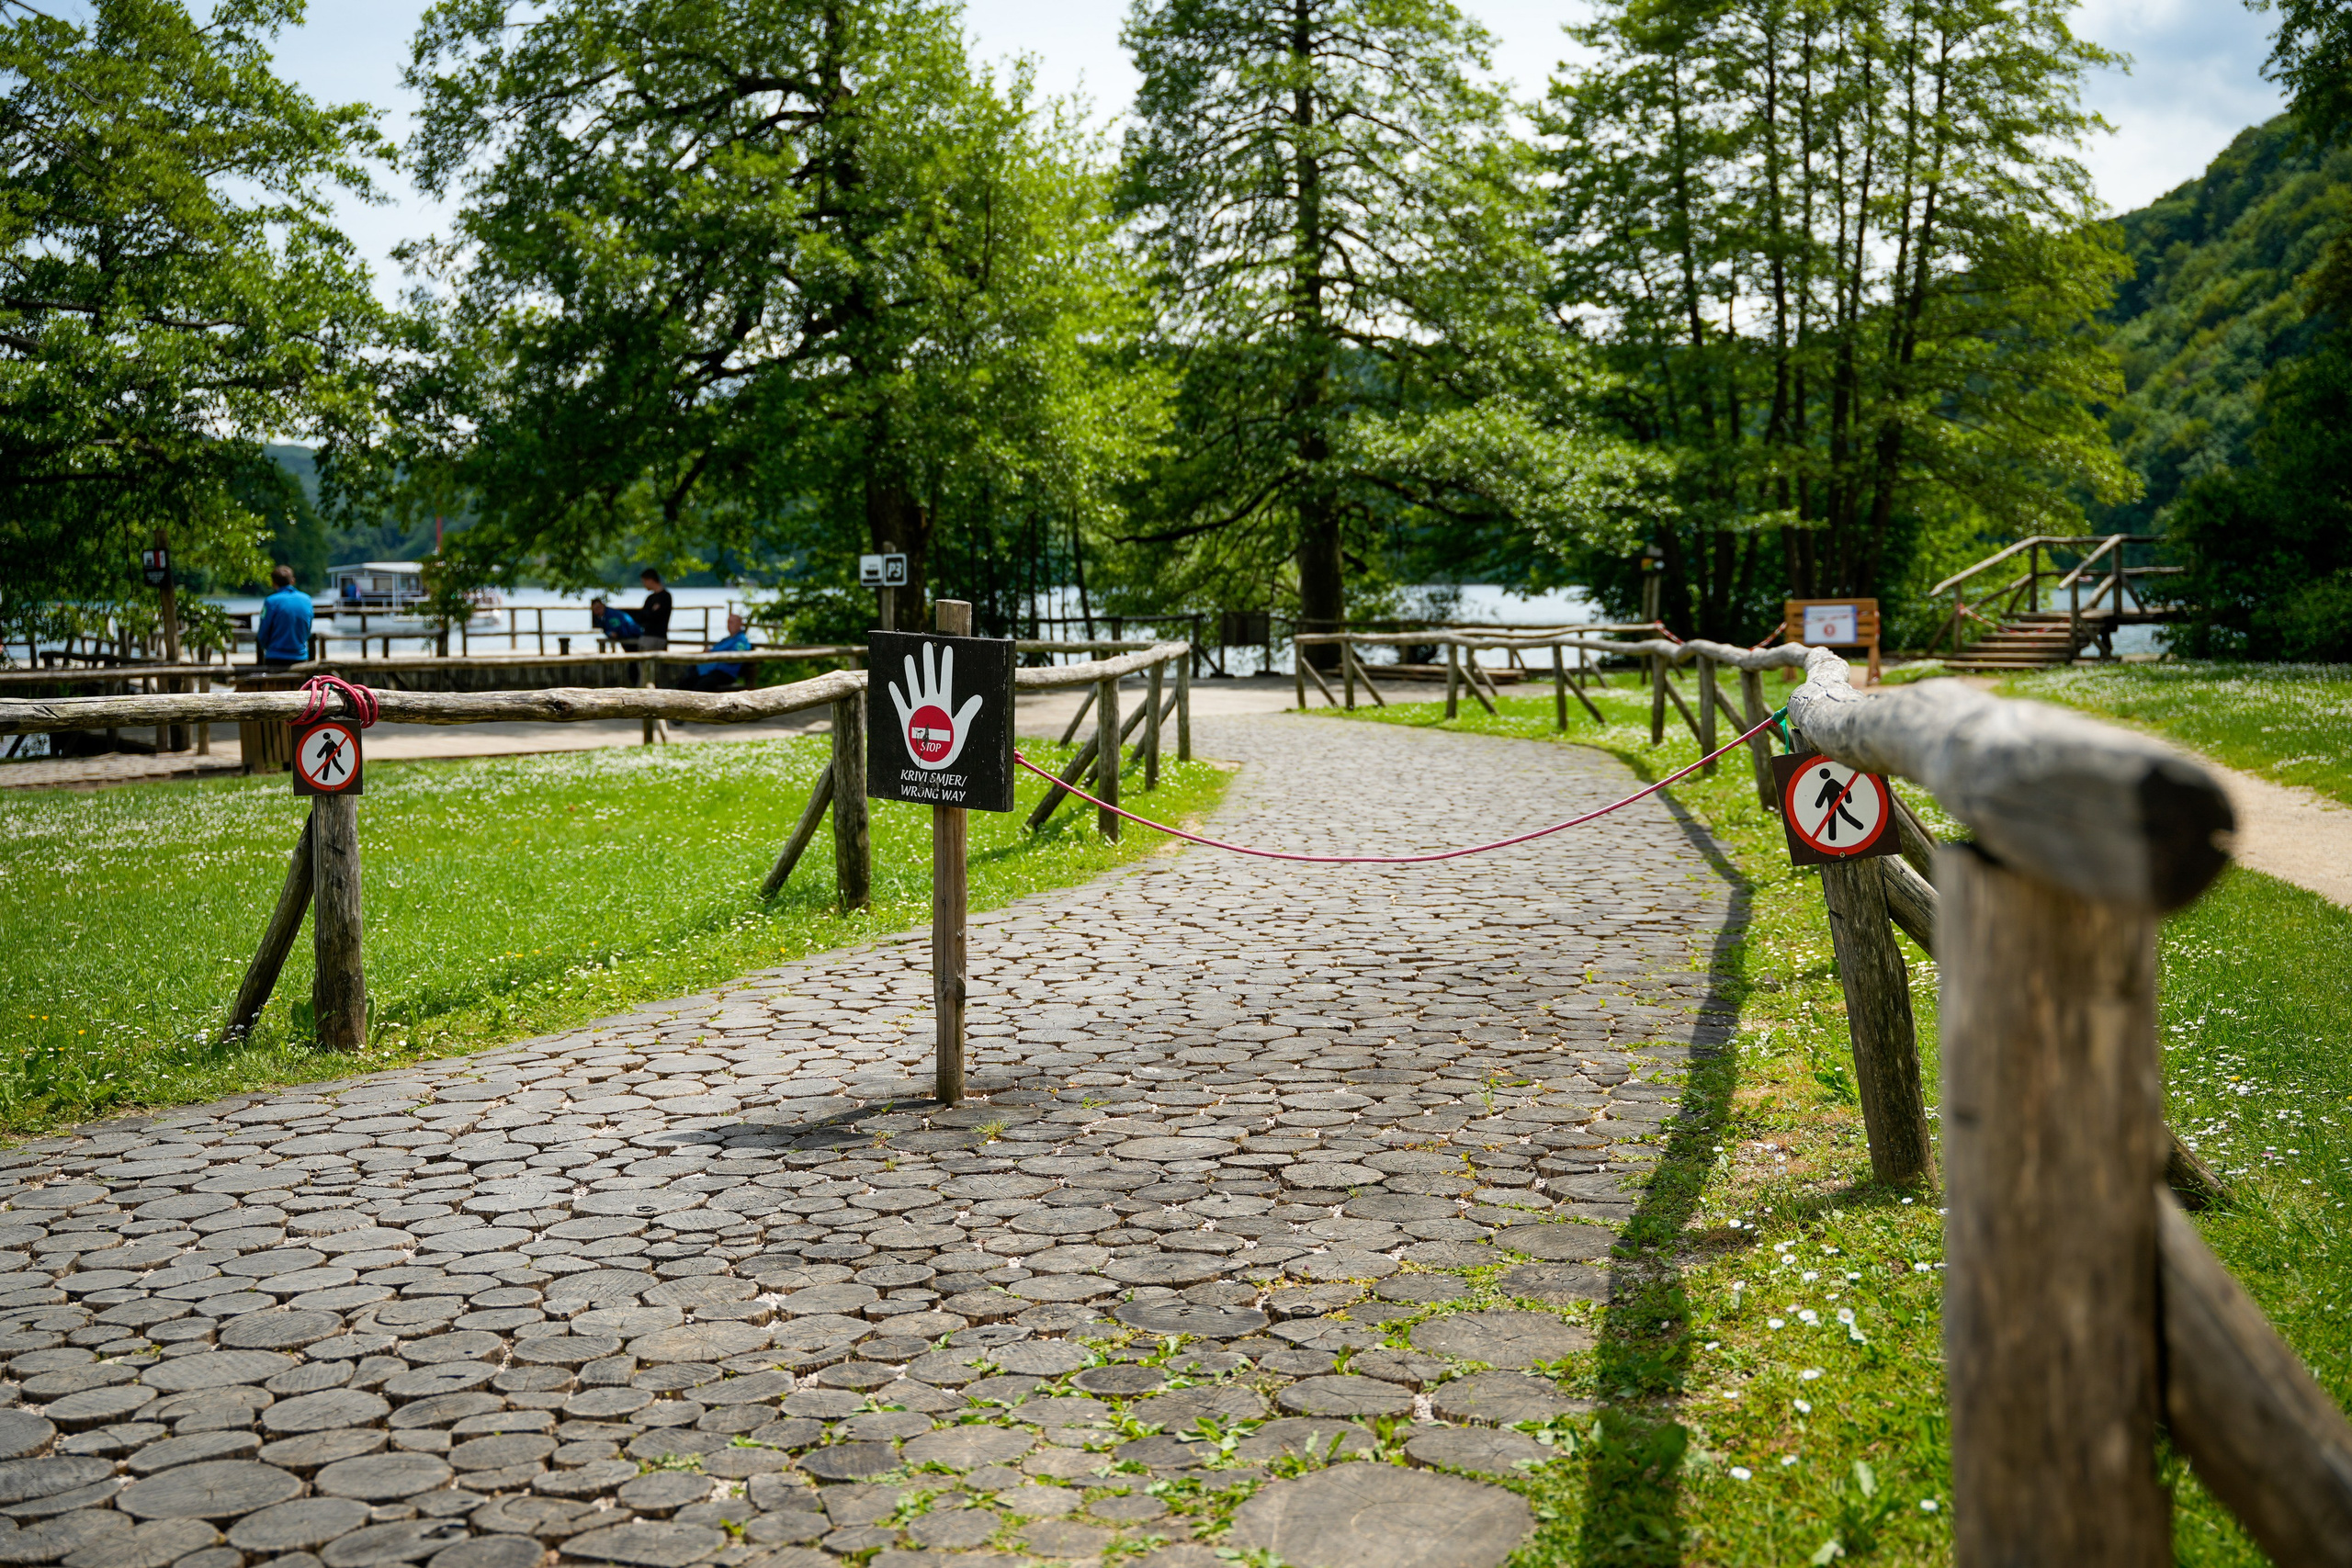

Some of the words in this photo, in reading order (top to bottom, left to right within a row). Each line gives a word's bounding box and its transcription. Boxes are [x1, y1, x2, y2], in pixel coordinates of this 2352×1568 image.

[888, 562, 902, 577] P3
[920, 741, 942, 752] STOP
[900, 769, 928, 783] KRIVI
[941, 789, 967, 802] WAY
